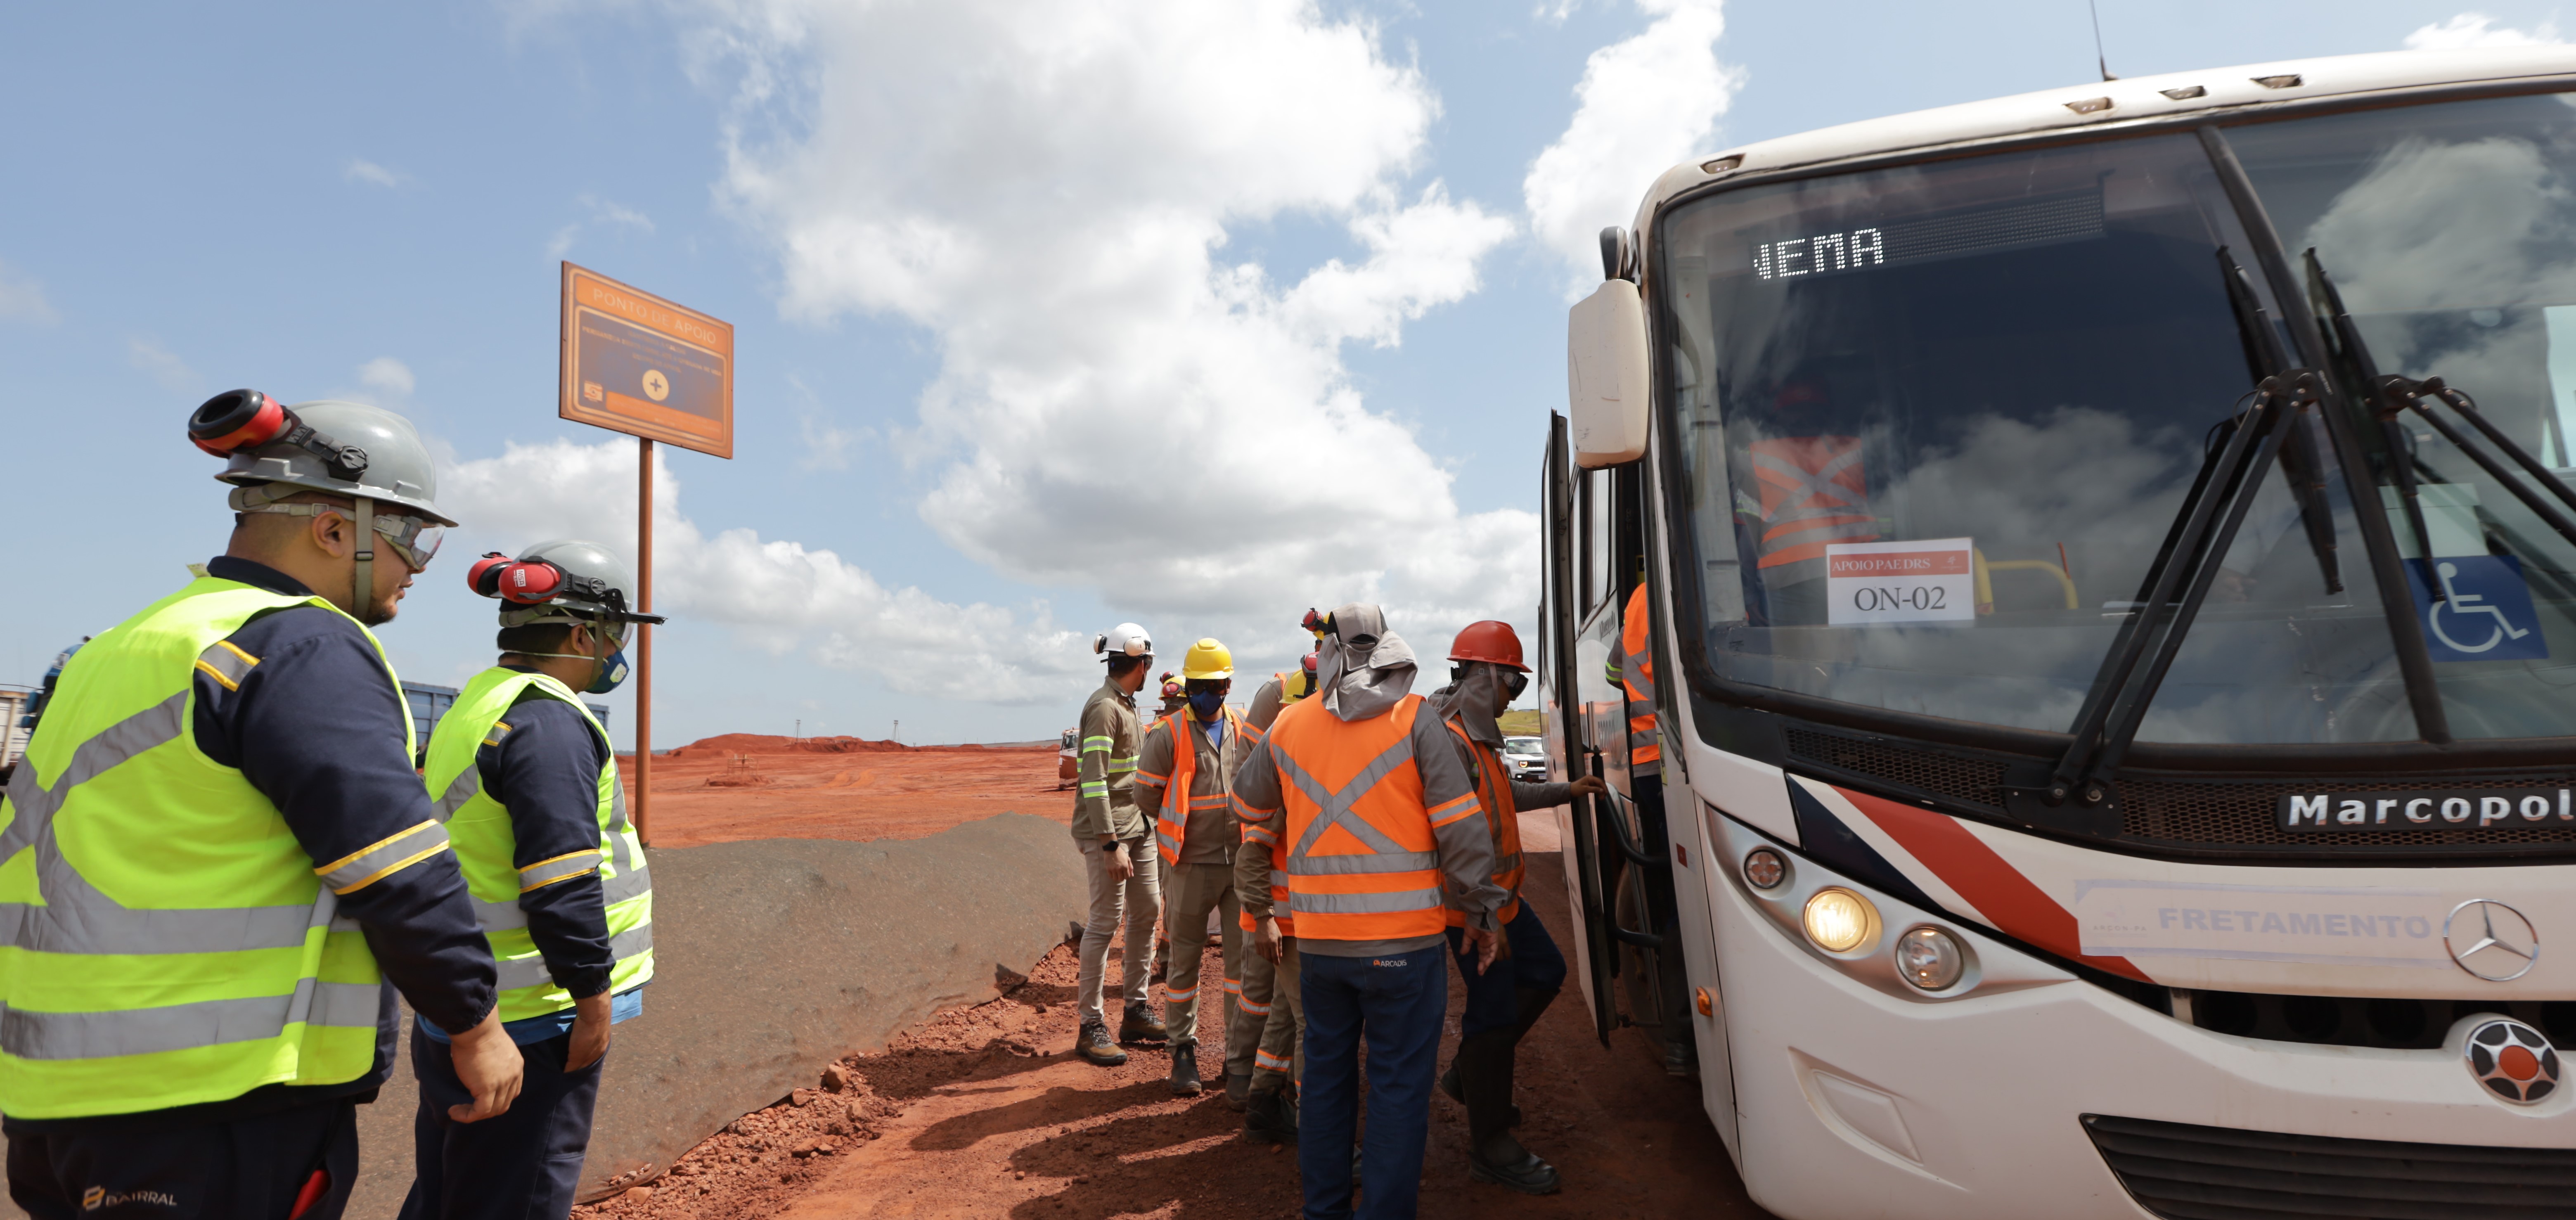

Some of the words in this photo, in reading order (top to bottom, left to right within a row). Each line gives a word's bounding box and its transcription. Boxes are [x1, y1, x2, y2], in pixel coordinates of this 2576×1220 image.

[593, 288, 647, 318] PONTO
[652, 310, 669, 327] DE
[675, 319, 716, 344] APOIO
[1832, 560, 1873, 571] APOIO
[1876, 559, 1901, 570] PAE
[1904, 558, 1931, 569] DRS
[1854, 586, 1946, 611] ON-02
[2288, 789, 2574, 826] Marcopol
[2158, 908, 2432, 939] FRETAMENTO
